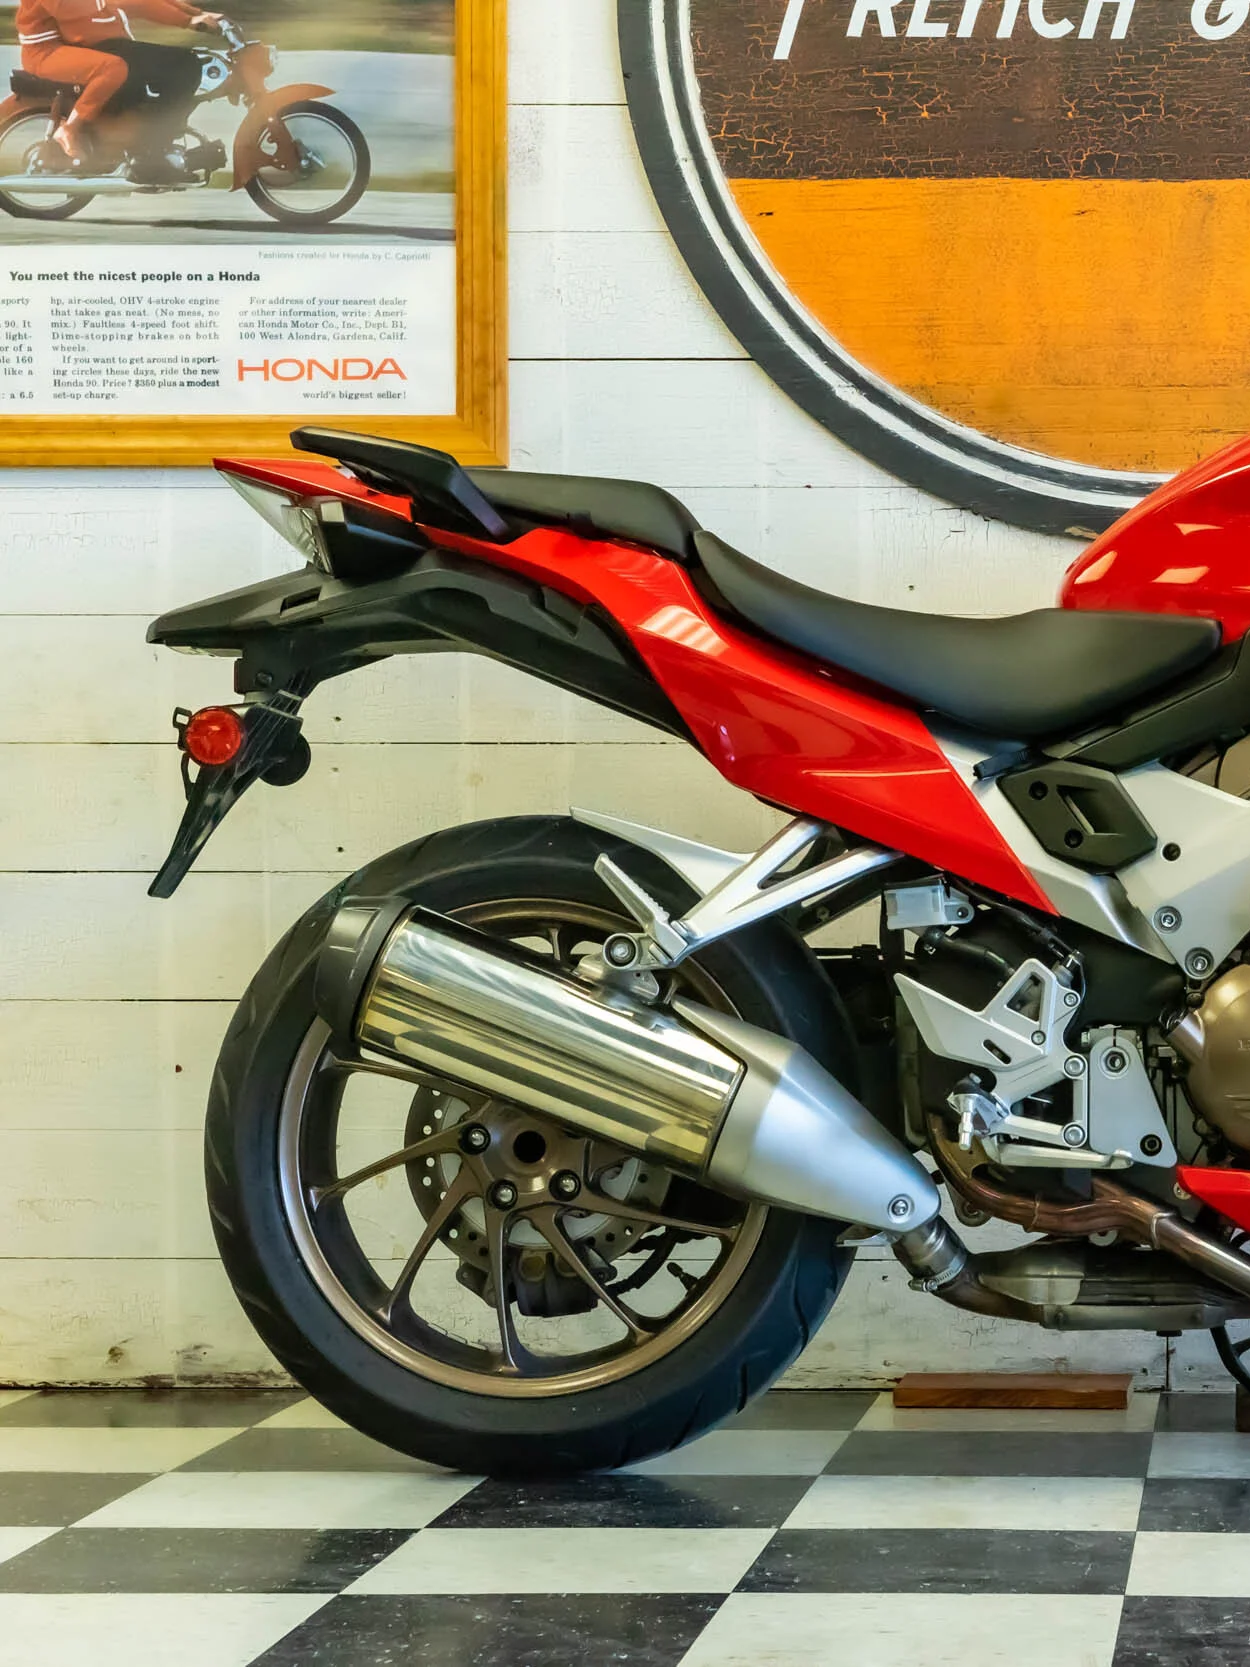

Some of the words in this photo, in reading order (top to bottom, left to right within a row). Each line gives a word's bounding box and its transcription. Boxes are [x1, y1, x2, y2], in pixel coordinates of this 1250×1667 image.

[343, 252, 369, 260] Honda
[10, 271, 32, 282] You
[38, 271, 68, 281] meet
[73, 270, 94, 281] the
[99, 271, 136, 281] nicest
[142, 272, 182, 283] people
[187, 273, 202, 282] on
[219, 271, 259, 282] Honda
[1, 297, 31, 306] sporty
[51, 296, 64, 306] hp,
[68, 296, 116, 305] air-cooled,
[120, 296, 143, 305] OHV
[189, 298, 219, 307] engine
[250, 296, 265, 305] For
[269, 296, 303, 305] address
[319, 298, 339, 306] your
[343, 298, 375, 306] nearest
[379, 296, 405, 306] dealer
[51, 307, 70, 317] that
[75, 307, 100, 317] takes
[105, 310, 121, 318] gas
[178, 310, 204, 318] mess,
[252, 308, 276, 317] other
[279, 308, 338, 317] information,
[83, 319, 125, 329] Faultless
[131, 319, 166, 330] 4-speed
[172, 319, 190, 329] foot
[195, 319, 218, 329] shift.
[239, 321, 254, 329] can
[258, 319, 288, 329] Honda
[291, 319, 319, 329] Motor
[52, 331, 133, 342] Dime-stopping
[138, 331, 174, 341] brakes
[179, 333, 191, 341] on
[196, 331, 219, 340] both
[240, 331, 255, 340] 100
[259, 331, 283, 340] West
[288, 331, 330, 341] Alondra,
[379, 331, 407, 341] Calif.
[93, 356, 116, 364] want
[129, 356, 144, 365] get
[147, 355, 178, 364] around
[192, 355, 219, 365] sport-
[4, 367, 23, 376] like
[53, 369, 67, 377] ing
[72, 367, 102, 376] circles
[106, 367, 129, 376] these
[133, 367, 156, 377] days,
[161, 367, 178, 376] ride
[183, 367, 197, 376] the
[201, 368, 219, 376] new
[237, 359, 408, 381] HONDA
[54, 378, 83, 388] Honda
[158, 378, 176, 389] plus
[187, 378, 219, 388] modest
[53, 391, 81, 401] set-up
[85, 390, 118, 400] charge.
[304, 390, 335, 399] world's
[340, 391, 372, 400] biggest
